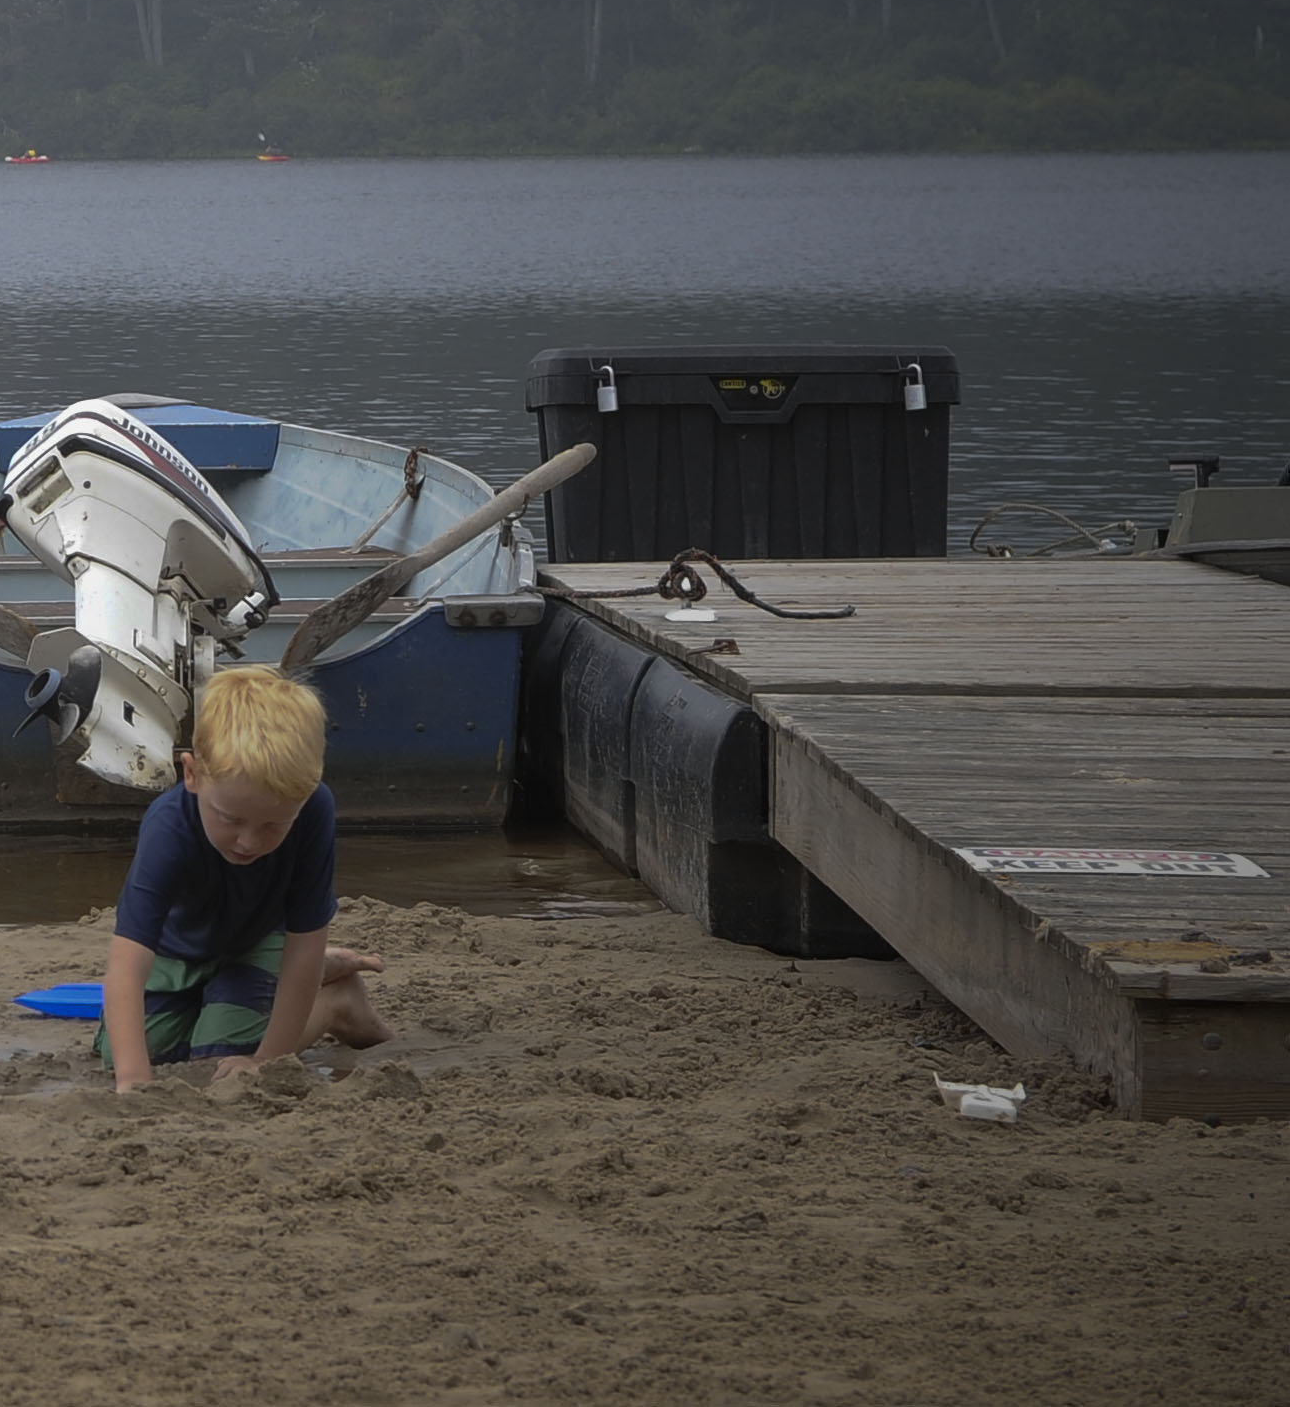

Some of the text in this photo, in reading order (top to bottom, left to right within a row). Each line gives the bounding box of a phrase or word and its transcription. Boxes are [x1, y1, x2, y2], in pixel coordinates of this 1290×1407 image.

[111, 416, 210, 494] Johnson
[987, 859, 1237, 874] KEEP OUT
